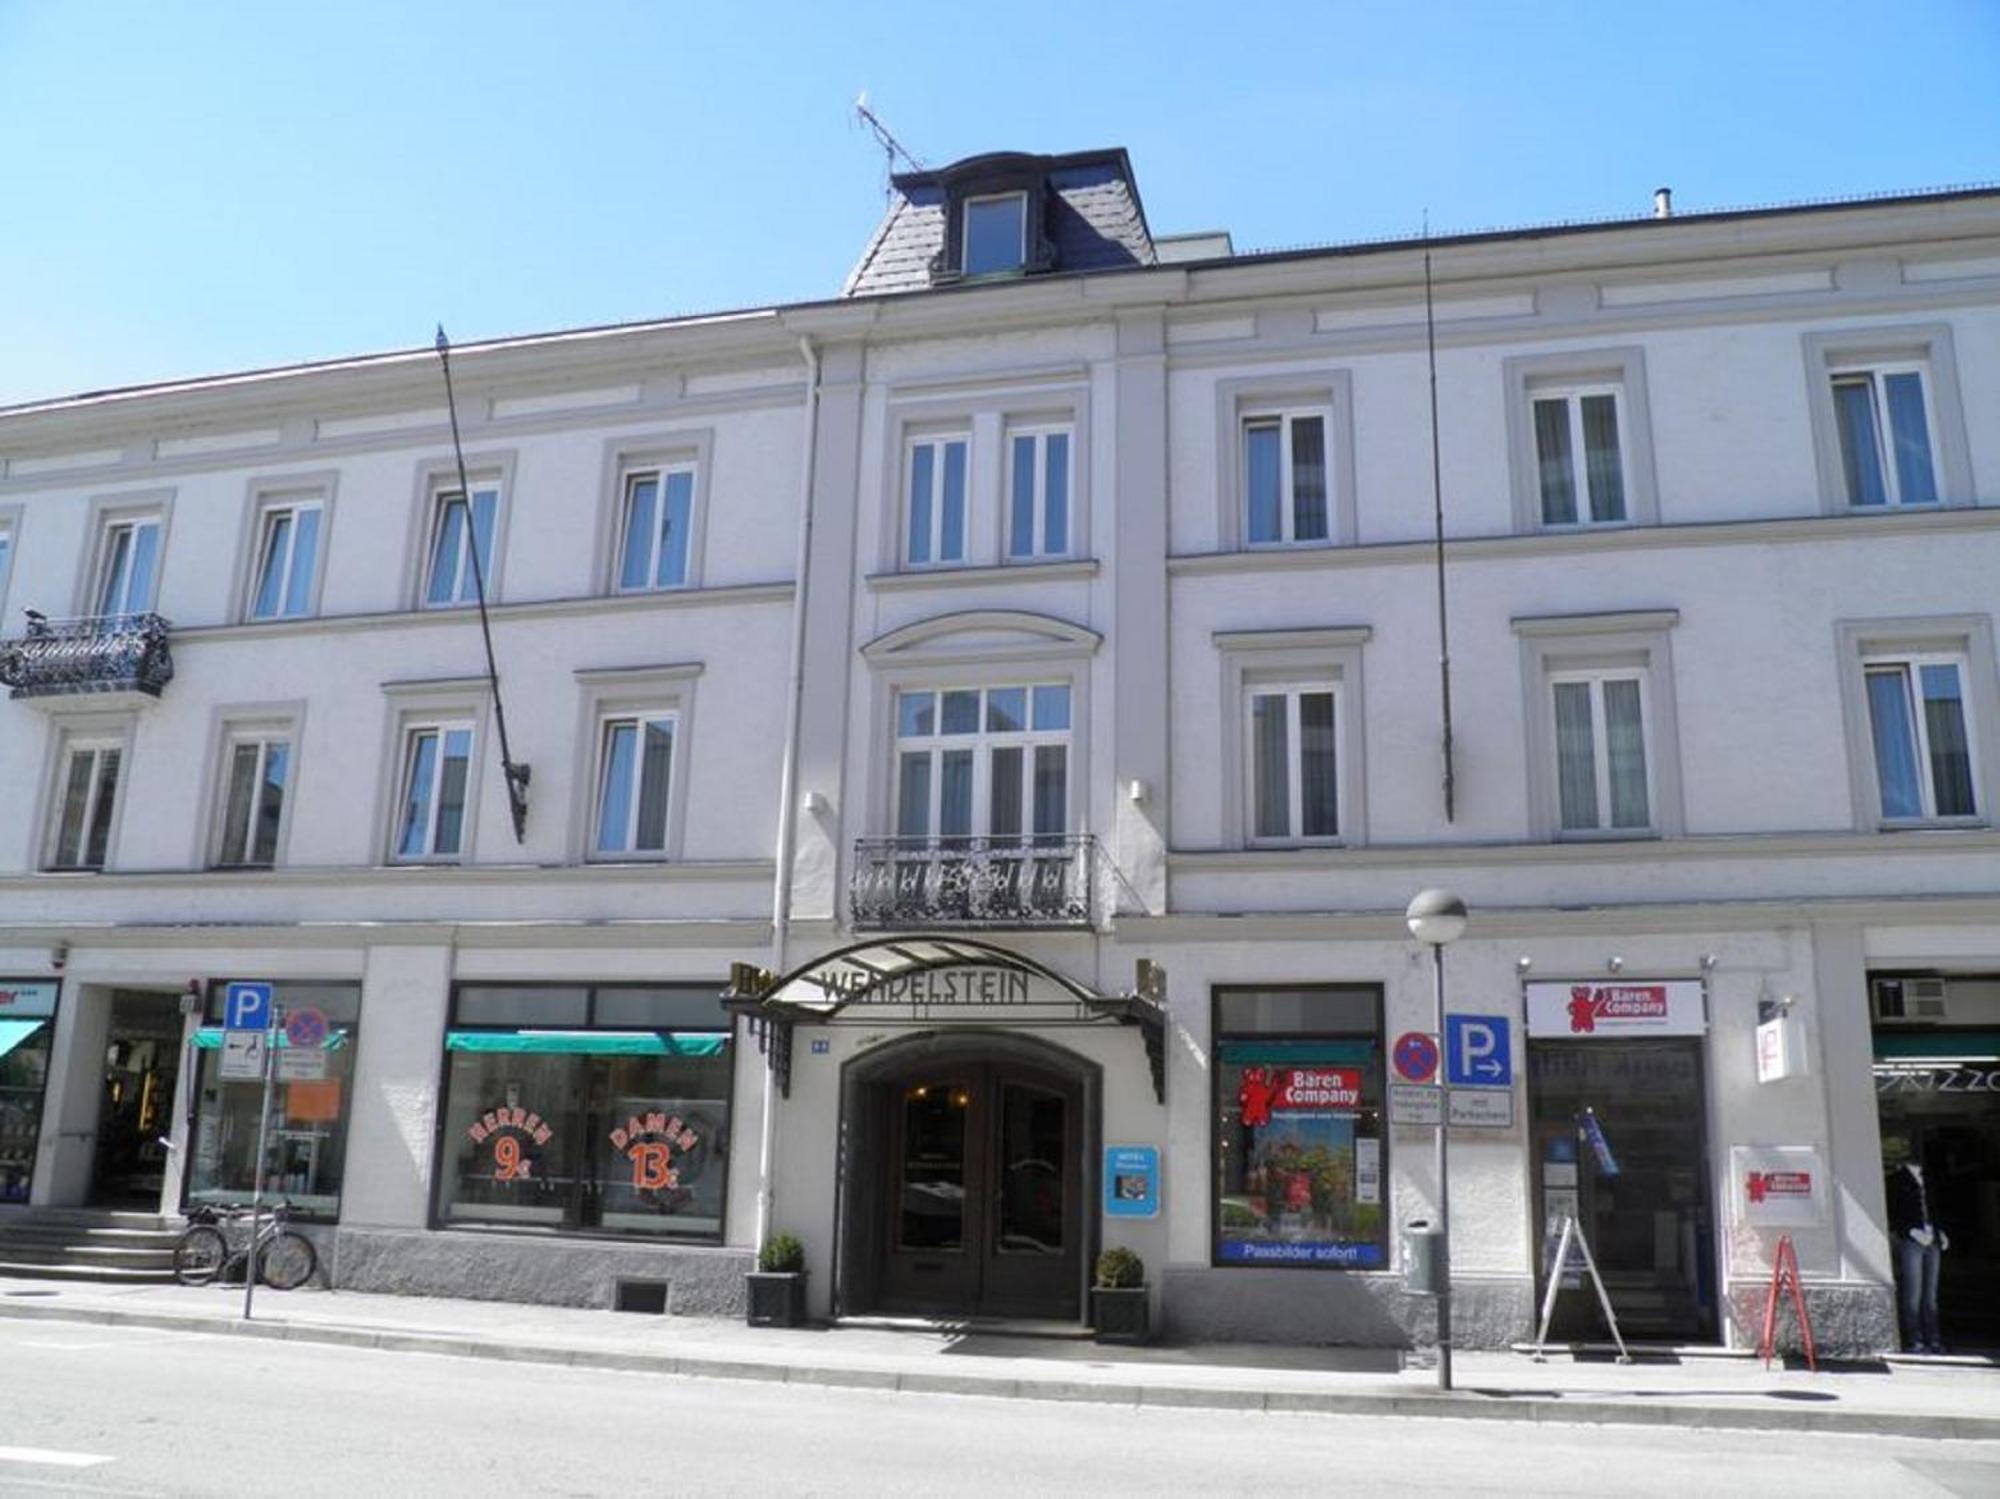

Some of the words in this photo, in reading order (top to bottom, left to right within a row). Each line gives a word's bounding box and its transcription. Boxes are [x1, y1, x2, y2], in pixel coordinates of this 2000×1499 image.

[820, 971, 1029, 1003] WENDELSTEIN
[235, 990, 260, 1026] P
[1461, 1023, 1495, 1076] P
[1284, 1087, 1359, 1105] Company
[1293, 1070, 1343, 1088] Bären
[469, 1107, 553, 1146] HERREN
[608, 1112, 699, 1152] DAMEN
